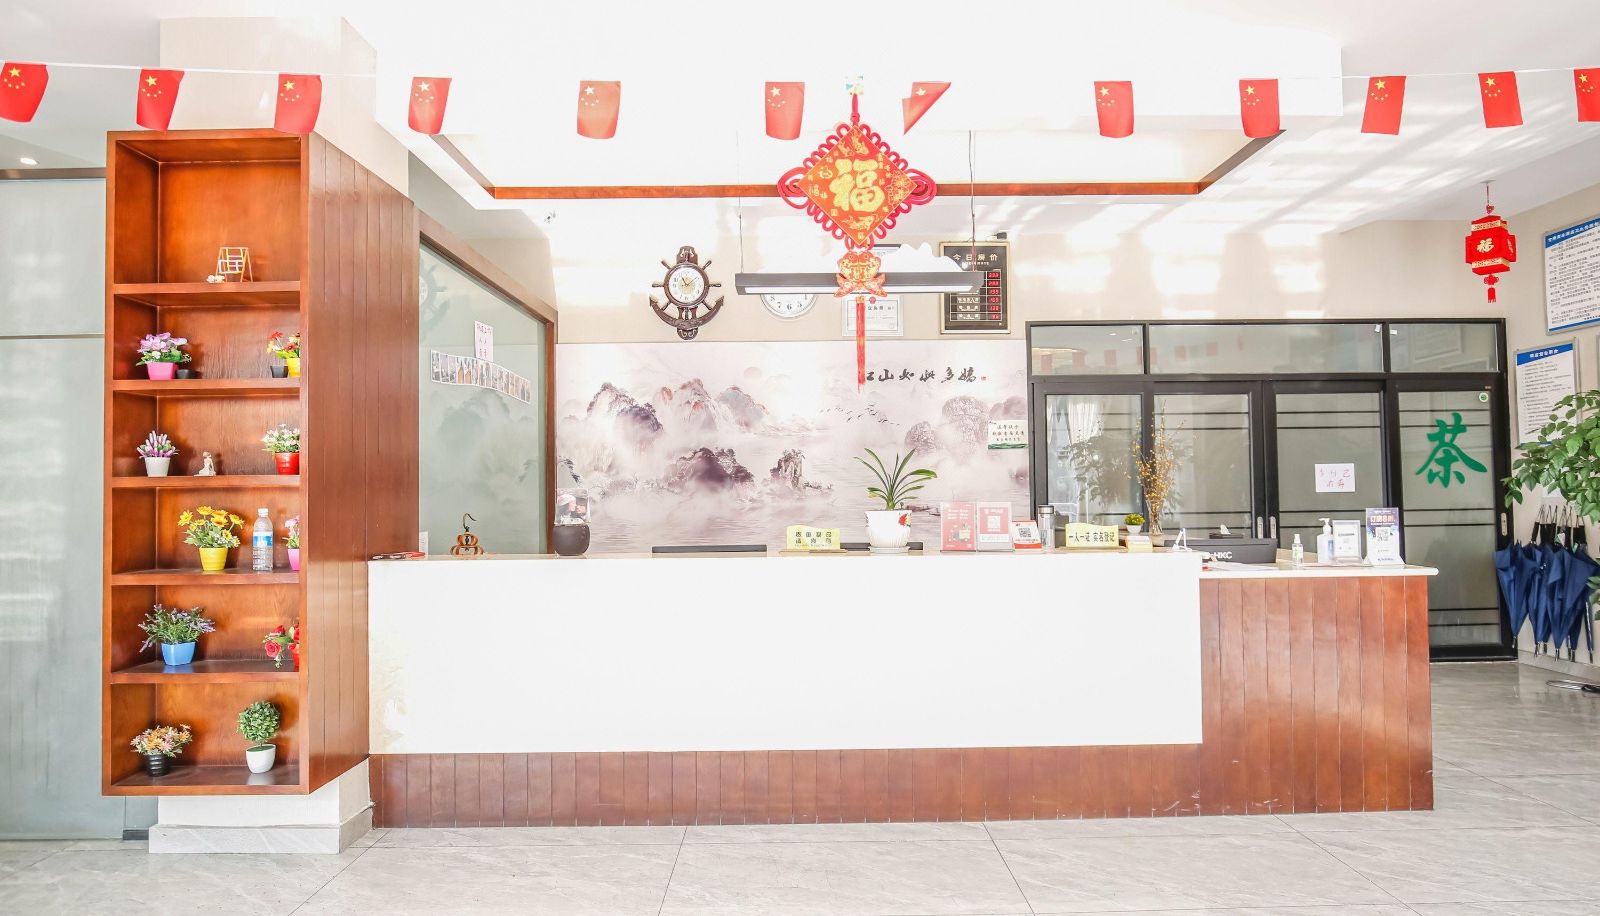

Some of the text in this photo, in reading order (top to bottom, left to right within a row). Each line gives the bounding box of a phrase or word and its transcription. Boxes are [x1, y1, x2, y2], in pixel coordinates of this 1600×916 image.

[829, 158, 886, 213] 福
[1476, 237, 1495, 254] 福
[1414, 412, 1488, 488] 茶
